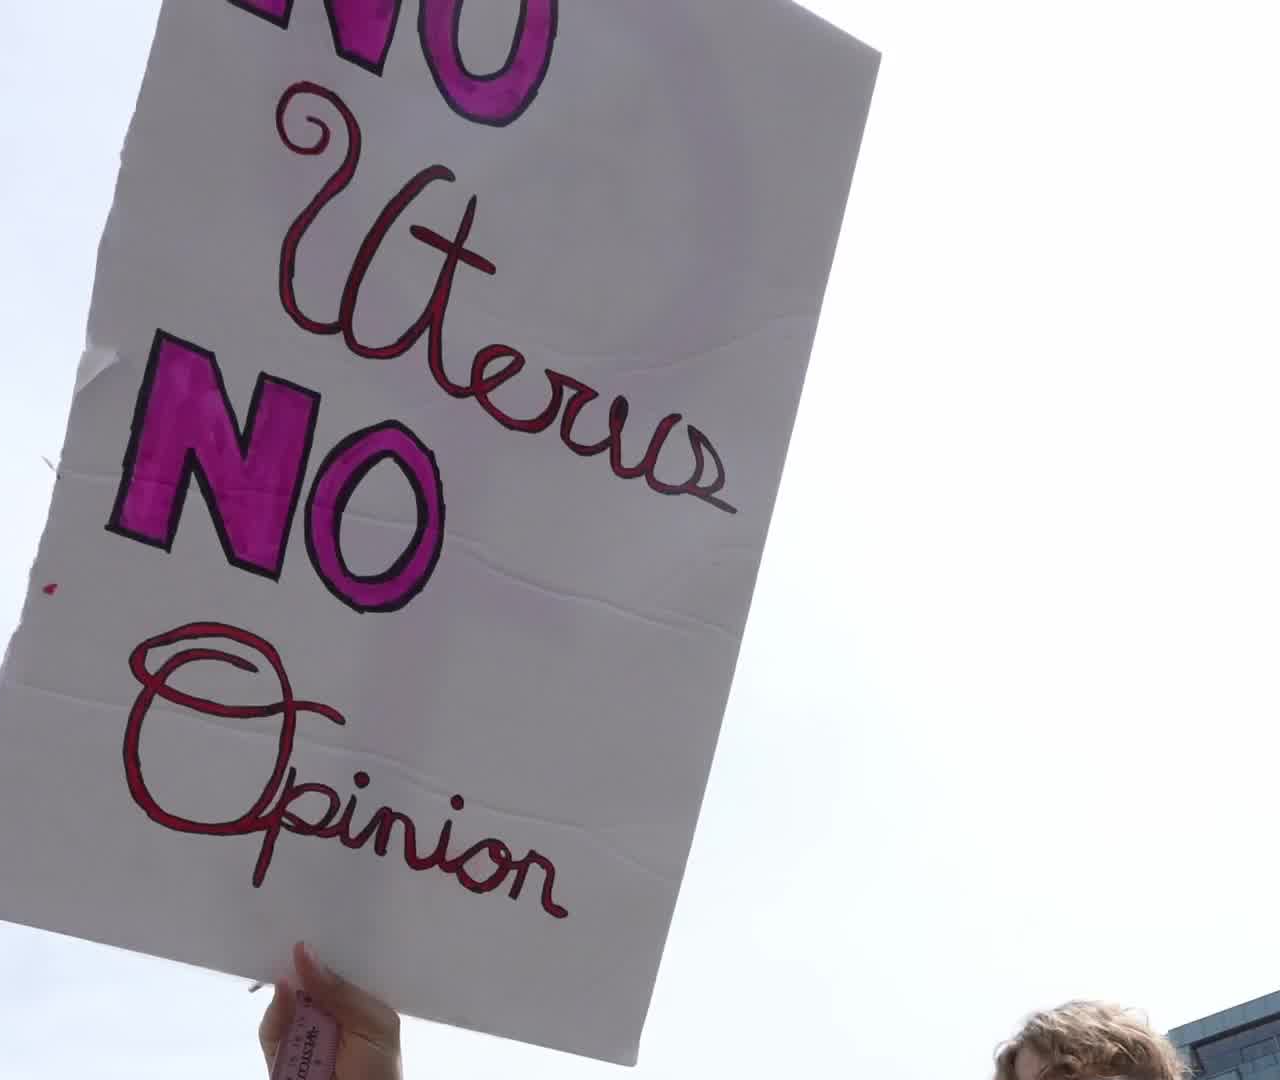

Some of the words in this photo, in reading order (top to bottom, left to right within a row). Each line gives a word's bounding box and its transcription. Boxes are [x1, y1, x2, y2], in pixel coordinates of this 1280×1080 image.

[276, 80, 737, 514] Uterus
[107, 328, 444, 613] NO
[123, 621, 569, 920] Opinion
